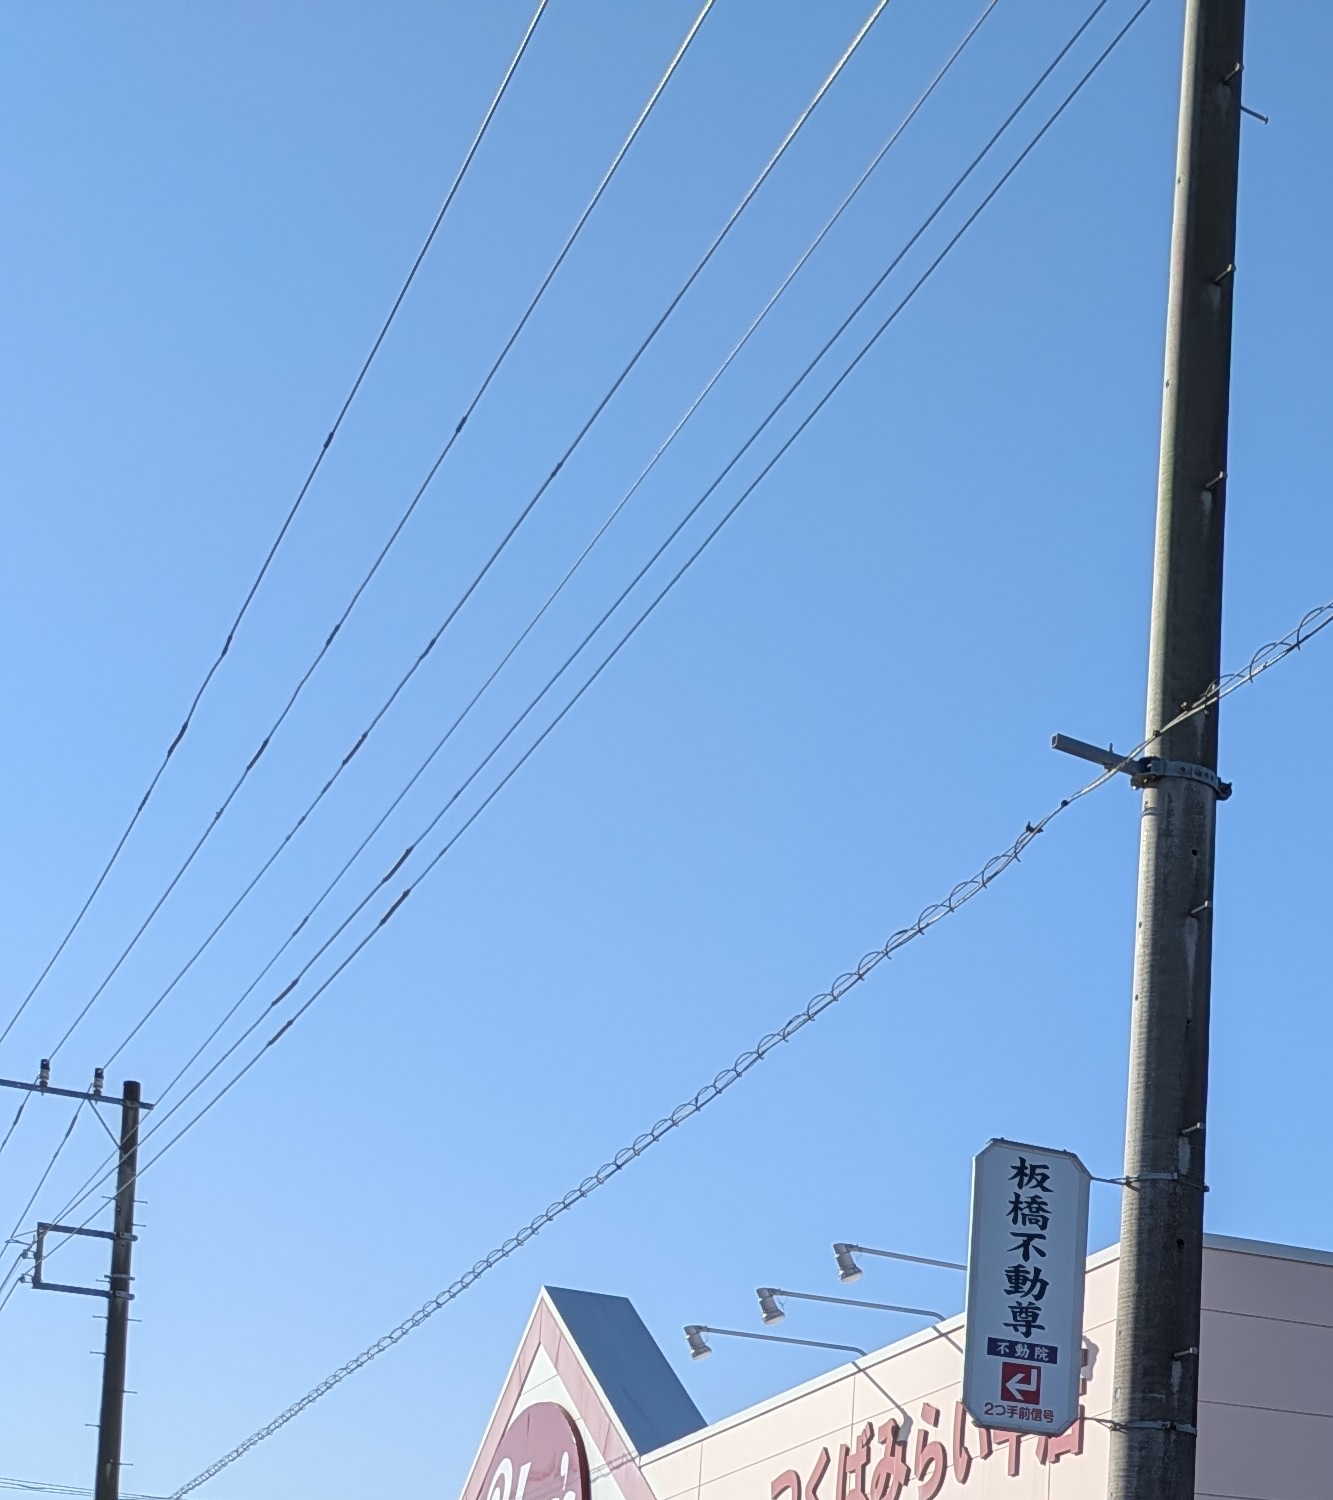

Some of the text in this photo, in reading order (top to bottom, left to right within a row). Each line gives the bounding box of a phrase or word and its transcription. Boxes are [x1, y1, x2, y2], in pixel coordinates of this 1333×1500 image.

[1003, 1156, 1054, 1339] 板橋不動尊
[996, 1341, 1050, 1362] 不動院
[984, 1401, 1055, 1424] 2つ手前信号
